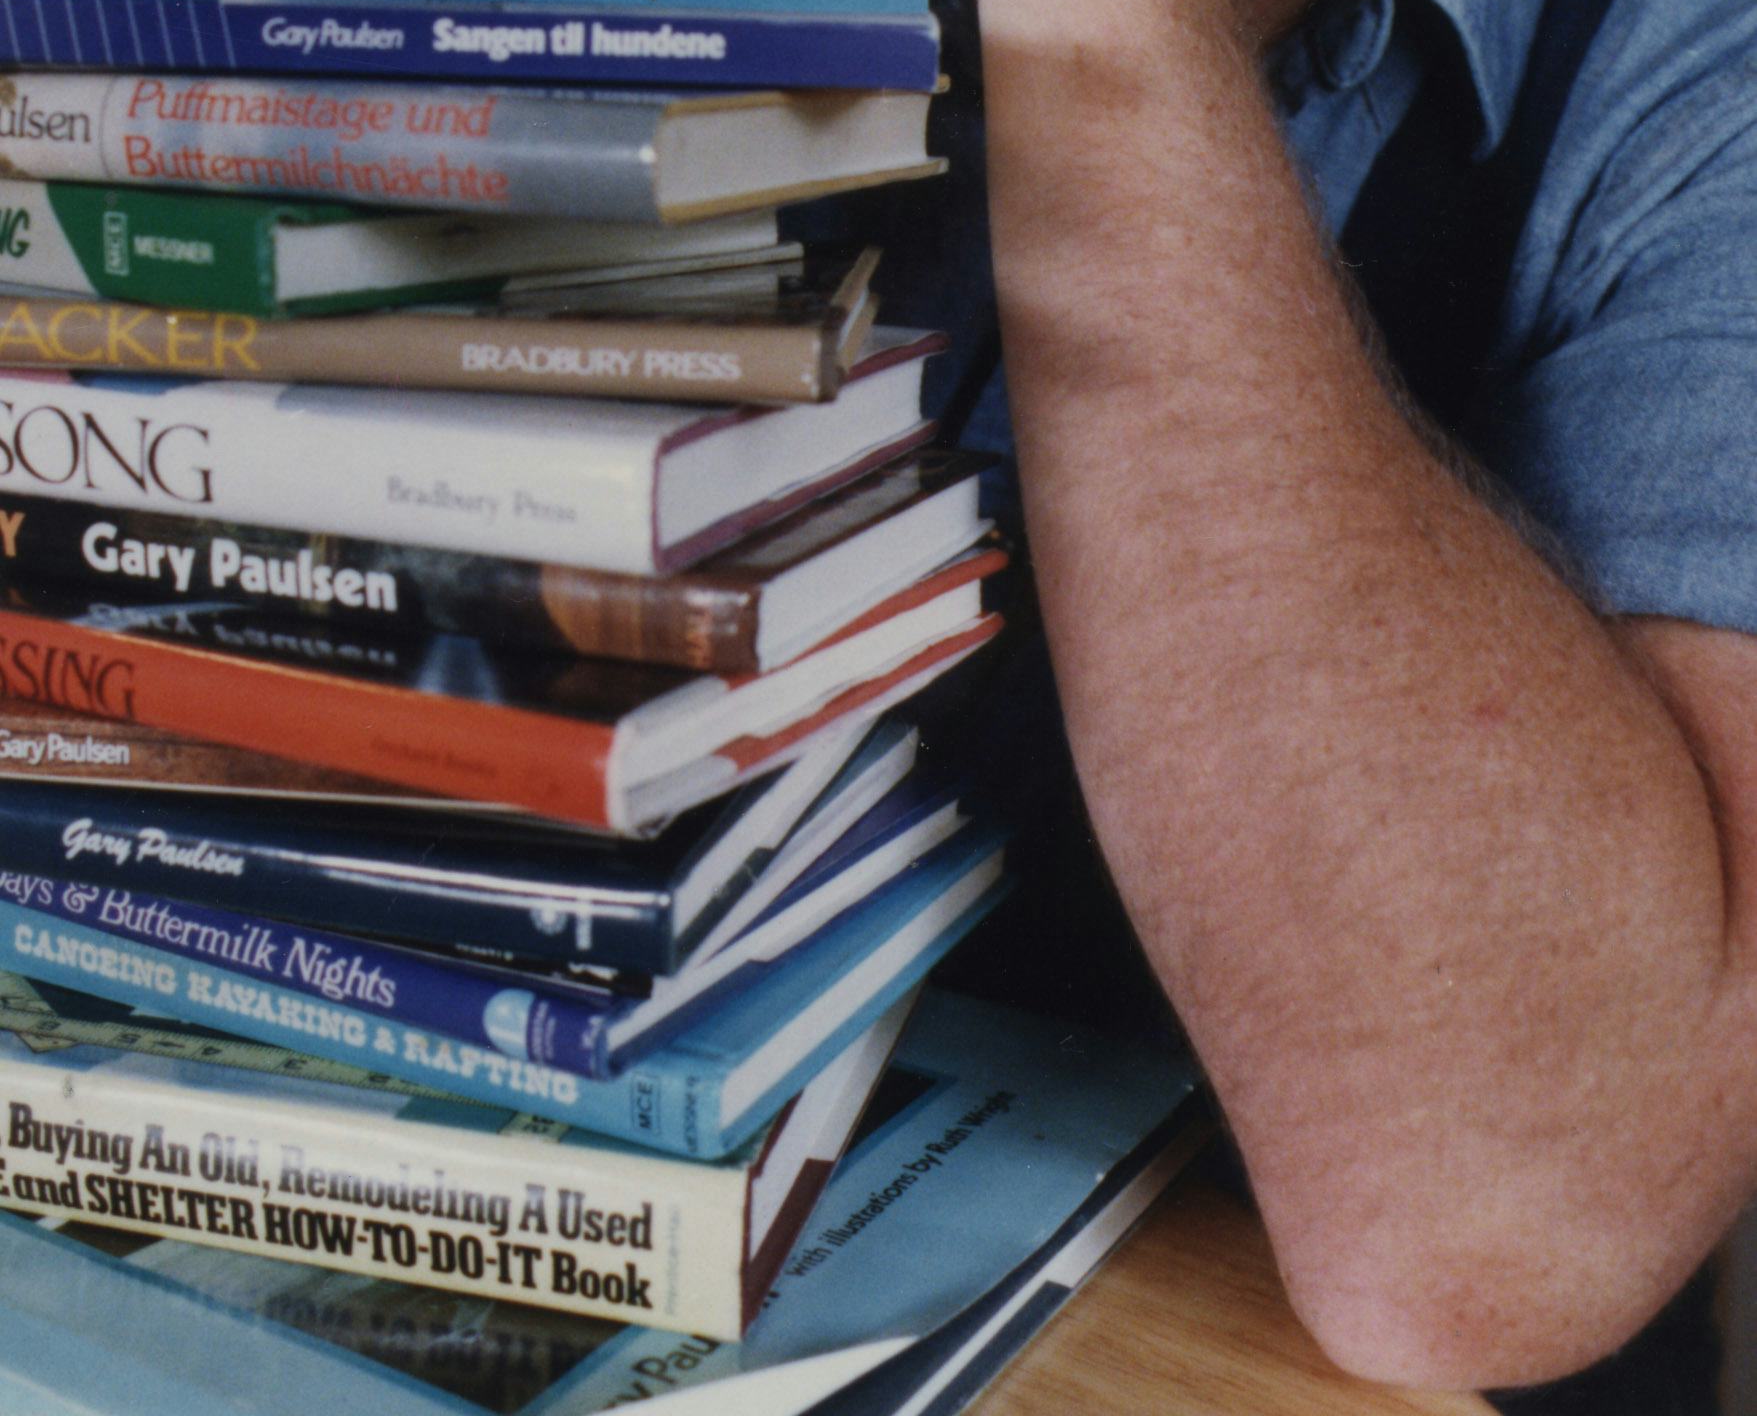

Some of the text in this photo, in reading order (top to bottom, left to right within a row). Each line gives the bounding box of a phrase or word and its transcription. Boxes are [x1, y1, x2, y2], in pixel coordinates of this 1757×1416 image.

[262, 17, 404, 55] Gary Paulsen
[432, 17, 727, 62] Sangen til hundene
[127, 78, 497, 141] Puffmaistage und
[122, 134, 510, 203] Buttermilchnächte
[0, 300, 261, 372] ACKER
[461, 343, 741, 381] BRADBURY PRESS
[387, 475, 577, 524] Bradbury Press
[81, 521, 398, 612] Gary Paulsen
[0, 637, 135, 721] SING
[47, 732, 131, 765] Paulsen
[62, 817, 244, 877] Gary Paulsen
[0, 871, 398, 1009] ays & Buttermilk Nights
[14, 923, 179, 995] CANOEING
[187, 971, 368, 1047] KAYAKING
[373, 1025, 397, 1056] &
[403, 1029, 580, 1105] RAFTING
[8, 1100, 653, 1251] Buying An Old, Remodeling A Used
[785, 1246, 834, 1278] with
[824, 1170, 919, 1248] illustrations
[903, 1153, 943, 1174] by
[925, 1127, 973, 1156] Ruth
[12, 1169, 84, 1211] and
[85, 1172, 259, 1241] SHELTER
[262, 1201, 542, 1290] HOW-TO-DO-IT
[550, 1248, 653, 1310] Book
